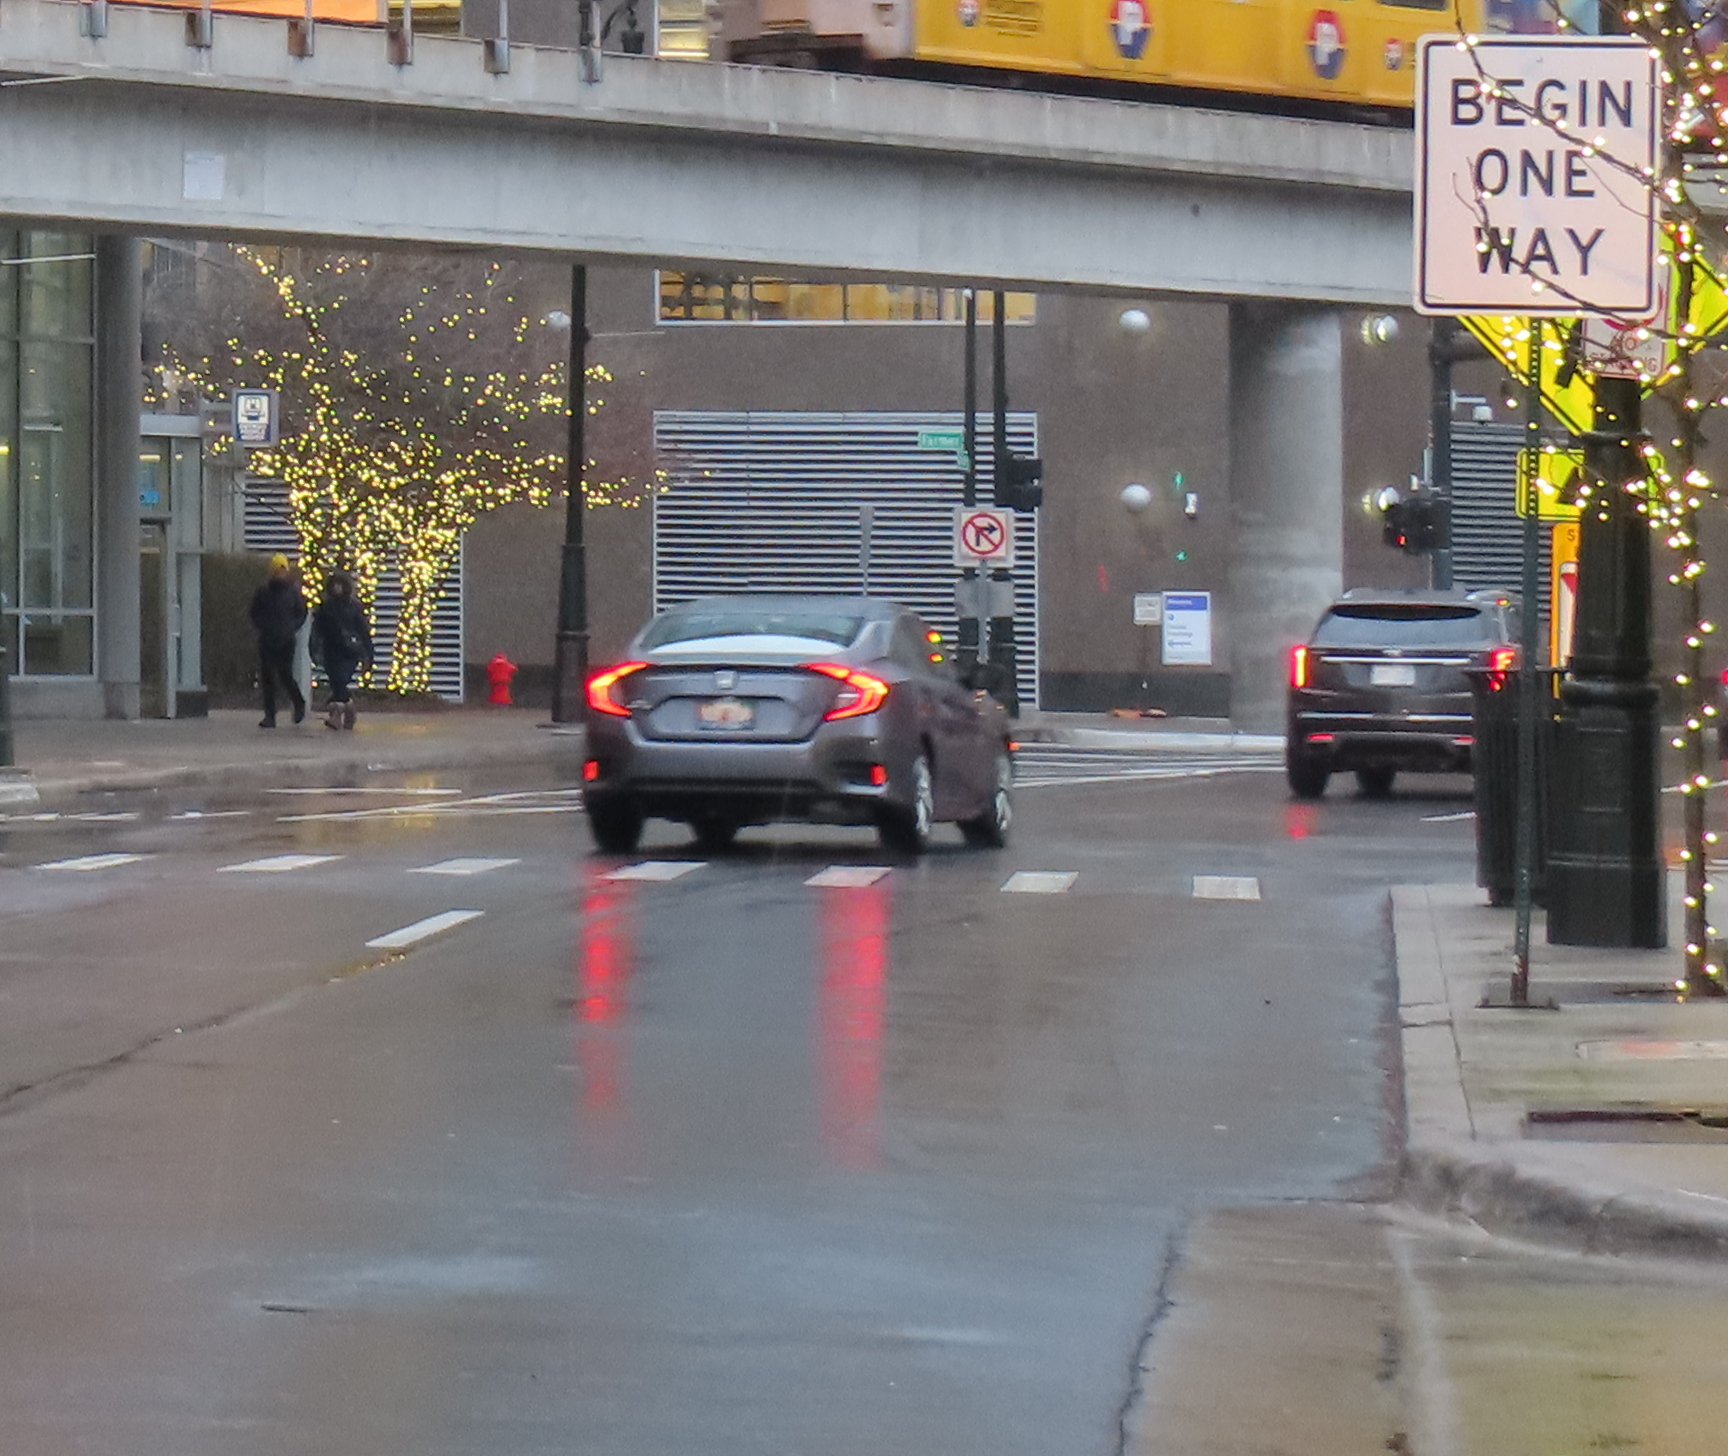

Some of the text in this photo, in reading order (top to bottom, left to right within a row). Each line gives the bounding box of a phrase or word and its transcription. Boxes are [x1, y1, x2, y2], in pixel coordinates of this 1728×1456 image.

[1451, 78, 1632, 128] BEGIN
[1475, 148, 1595, 197] ONE
[1474, 226, 1604, 276] WAY
